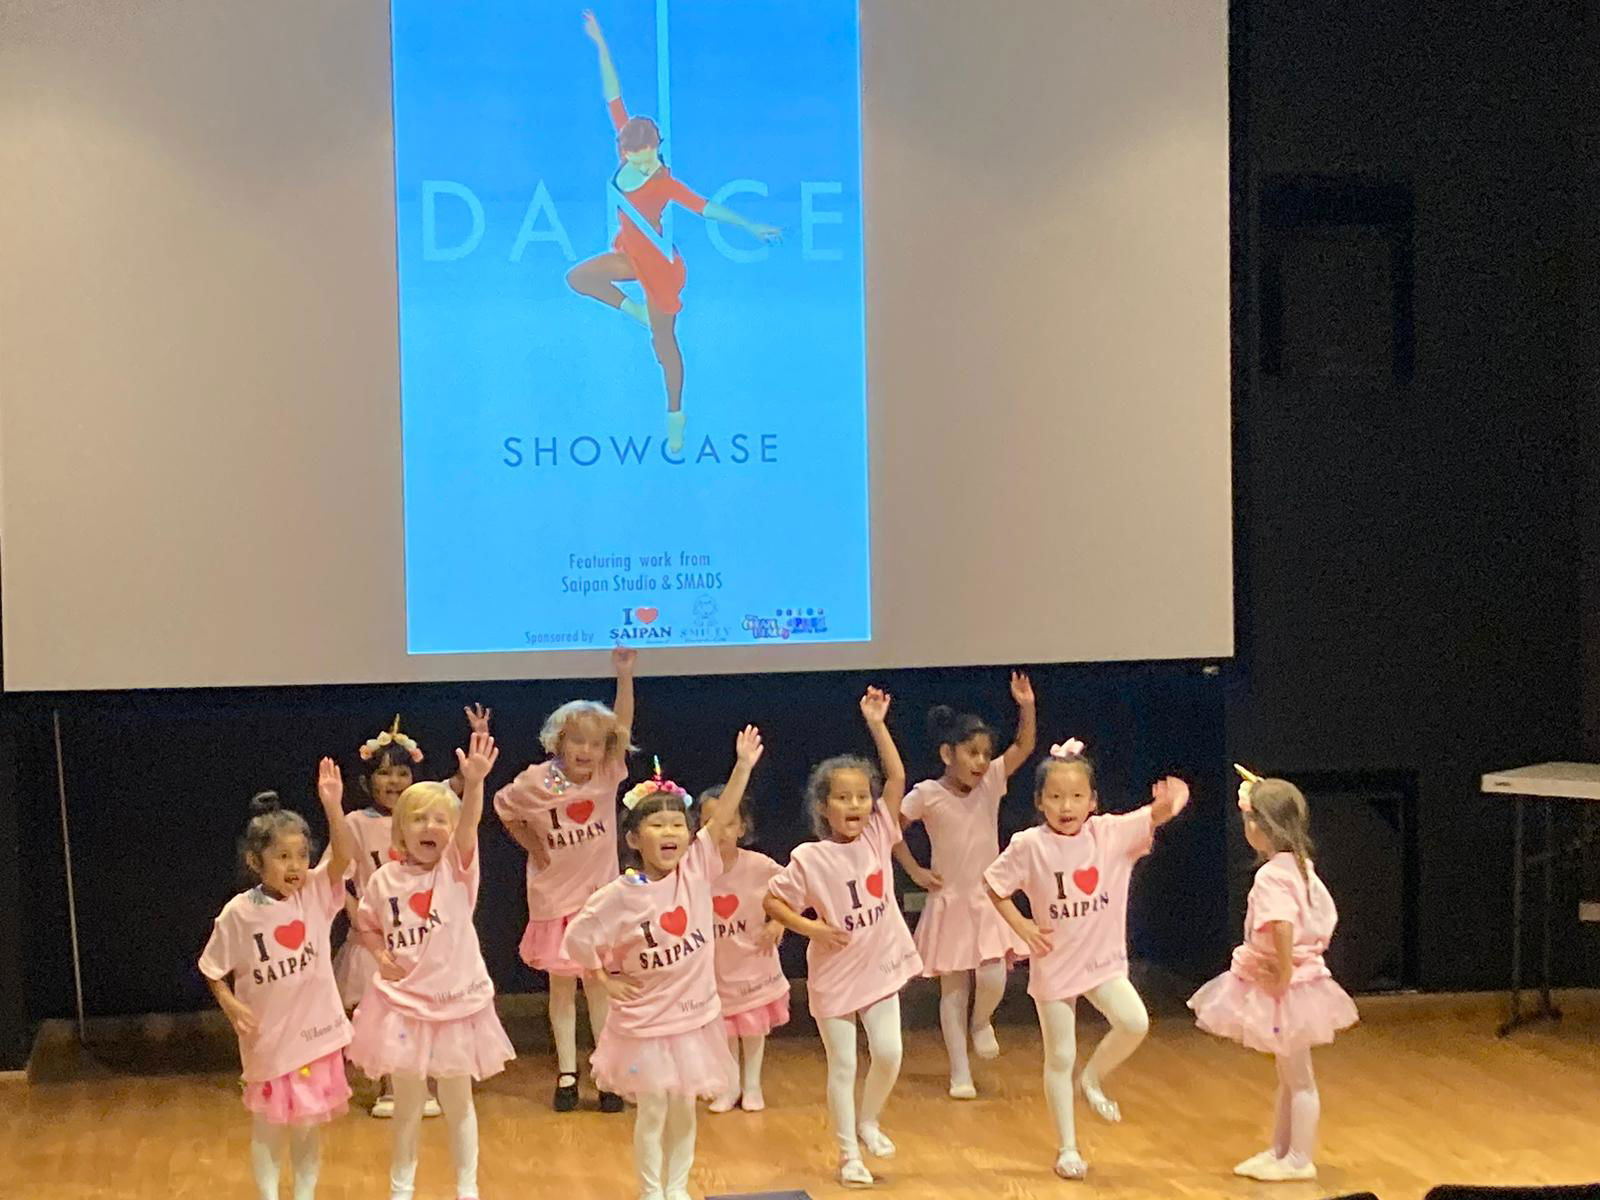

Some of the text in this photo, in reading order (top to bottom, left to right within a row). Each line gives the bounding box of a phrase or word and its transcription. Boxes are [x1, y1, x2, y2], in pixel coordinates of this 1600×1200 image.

[421, 178, 843, 264] DANCE
[502, 433, 779, 468] SHOWCASE
[568, 550, 711, 572] Featuring work from
[561, 572, 723, 597] Saipan Studio & SMADS
[622, 607, 633, 626] I
[524, 630, 595, 645] Sponsored by
[609, 626, 672, 640] SAIPAN
[547, 807, 562, 830] I
[545, 820, 607, 850] SAIPAN
[846, 880, 863, 910] I
[1054, 871, 1068, 900] I
[388, 896, 402, 928] I
[387, 908, 442, 952] SAIPN
[639, 920, 658, 949] I
[253, 932, 270, 963] I
[638, 928, 706, 970] SAIPAN
[253, 941, 315, 985] SAIPAN
